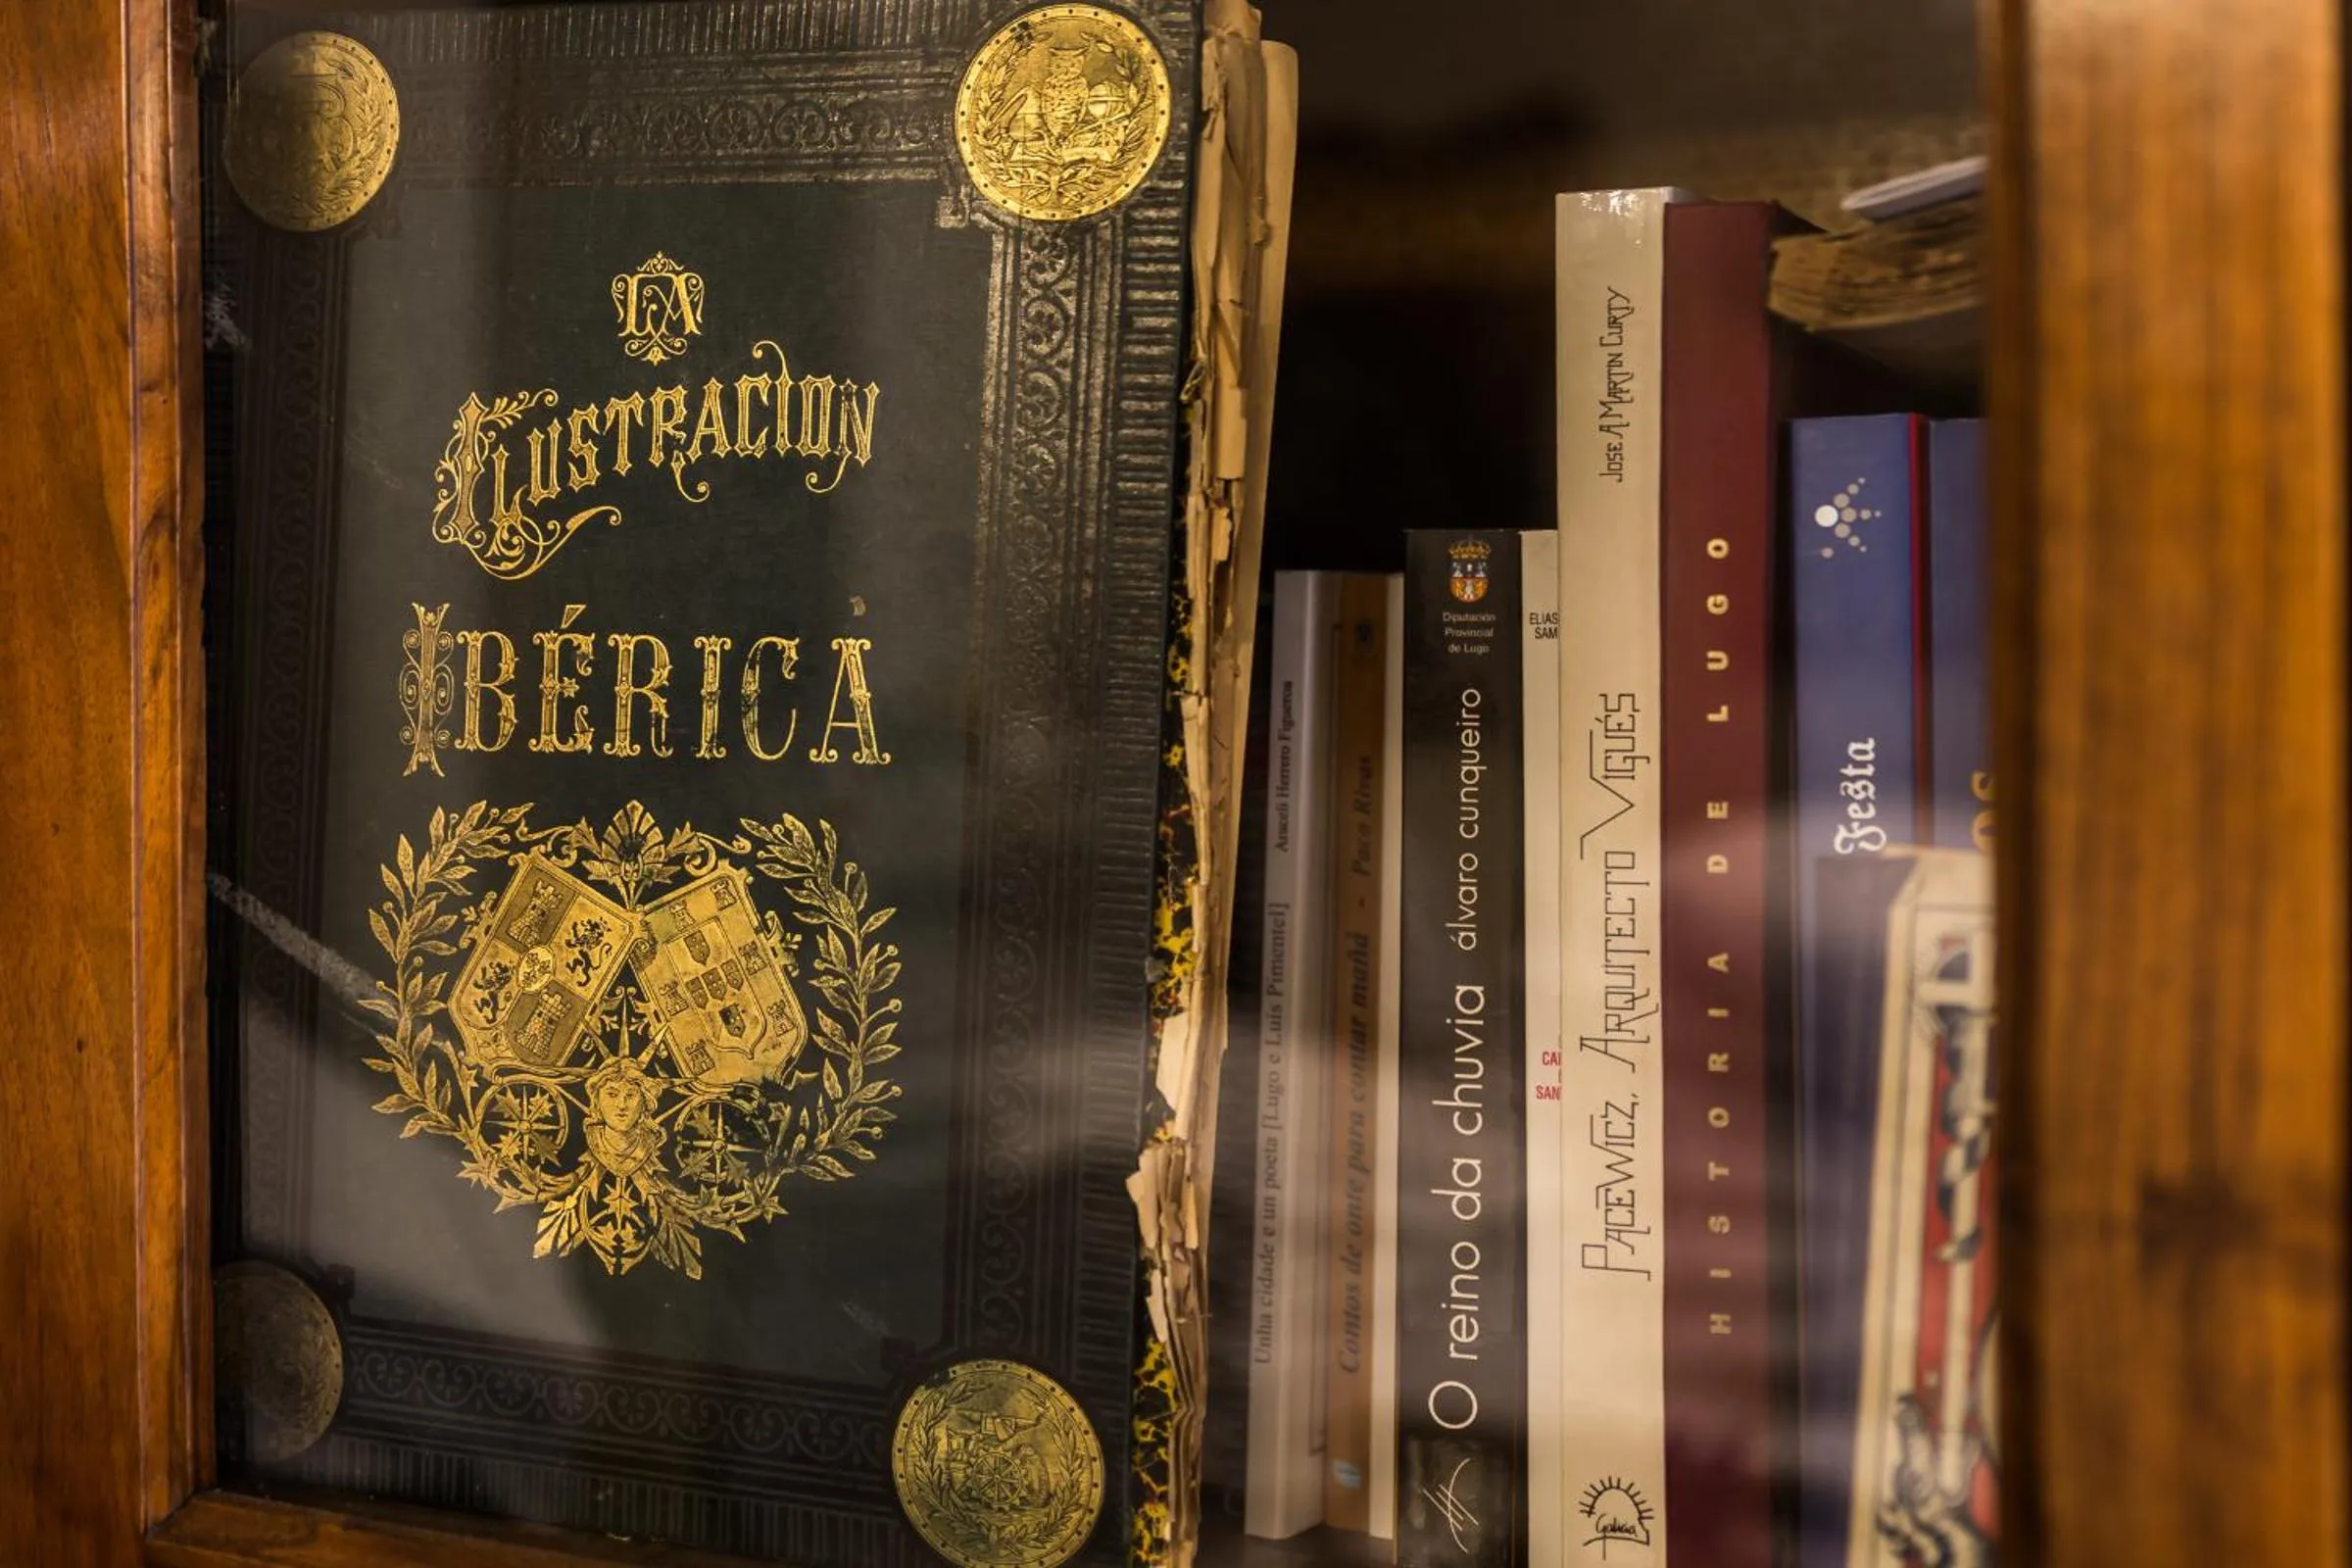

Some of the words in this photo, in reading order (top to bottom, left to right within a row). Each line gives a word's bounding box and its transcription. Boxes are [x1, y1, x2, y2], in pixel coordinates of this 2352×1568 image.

[611, 251, 704, 366] LA
[1598, 285, 1636, 347] CURTY
[1598, 353, 1635, 418] MARTIN
[1598, 421, 1631, 439] A
[1598, 442, 1624, 483] JOSE
[1445, 627, 1494, 637] Provincial
[1447, 644, 1461, 654] de
[1463, 644, 1491, 656] Lugo
[1529, 612, 1559, 625] ELIAS
[1706, 537, 1730, 722] LUGO
[399, 600, 892, 778] IBÉRICA
[1275, 745, 1293, 799] Herrero
[1455, 688, 1487, 839] cunqueiro
[1580, 693, 1650, 859] VIGUÉS
[1834, 737, 1886, 855] Festa
[1706, 802, 1730, 874] DE
[1446, 852, 1478, 951] álvaro
[1266, 902, 1291, 999] Pimentel]
[1580, 851, 1659, 1073] ARQUITECTO
[1271, 1053, 1283, 1065] e
[1346, 1014, 1370, 1103] contar
[1431, 984, 1486, 1135] chuvia
[1261, 1137, 1281, 1191] poeta
[1346, 1109, 1371, 1175] para
[1708, 953, 1732, 1335] HISTORIA
[1262, 1195, 1278, 1222] un
[1345, 1179, 1364, 1238] onte
[1431, 1157, 1483, 1221] da
[1263, 1227, 1277, 1238] e
[1339, 1244, 1363, 1276] de
[1255, 1244, 1275, 1307] cidade
[1442, 1241, 1482, 1360] reino
[1254, 1310, 1275, 1364] Unha
[1338, 1283, 1362, 1374] Contos
[1428, 1381, 1478, 1429] O
